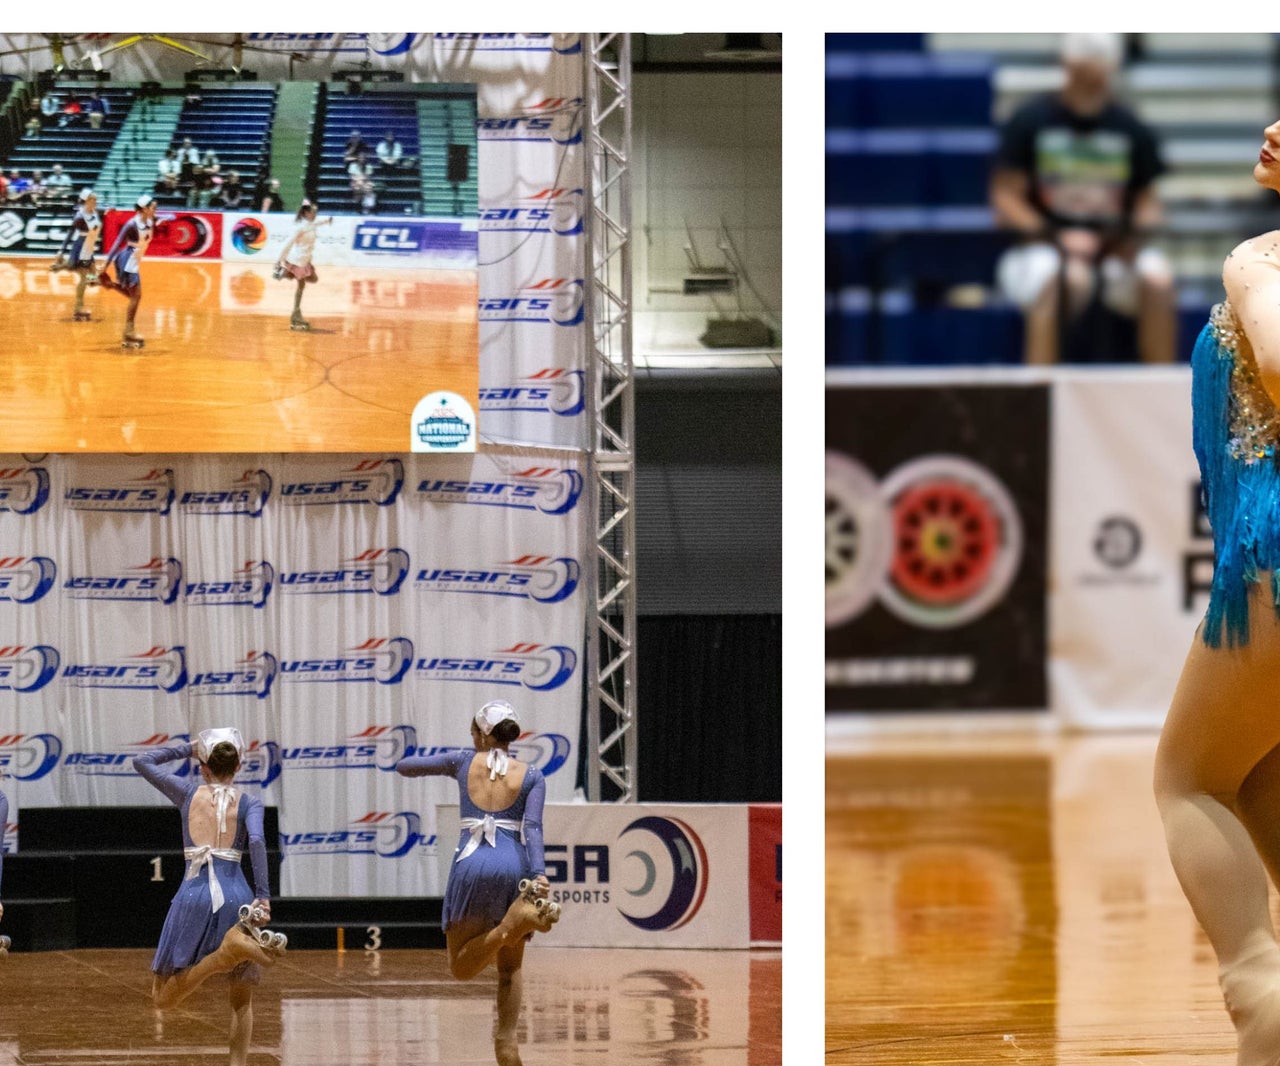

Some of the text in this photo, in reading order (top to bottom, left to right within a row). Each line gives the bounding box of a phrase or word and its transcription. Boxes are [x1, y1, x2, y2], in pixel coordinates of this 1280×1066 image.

[358, 227, 418, 249] TCL
[417, 480, 539, 497] usars
[416, 569, 532, 586] usars
[416, 658, 525, 673] usars
[64, 753, 138, 765] usar
[149, 856, 165, 882] 1
[544, 845, 609, 883] SA
[553, 890, 610, 904] SPORTS
[364, 925, 382, 950] 3
